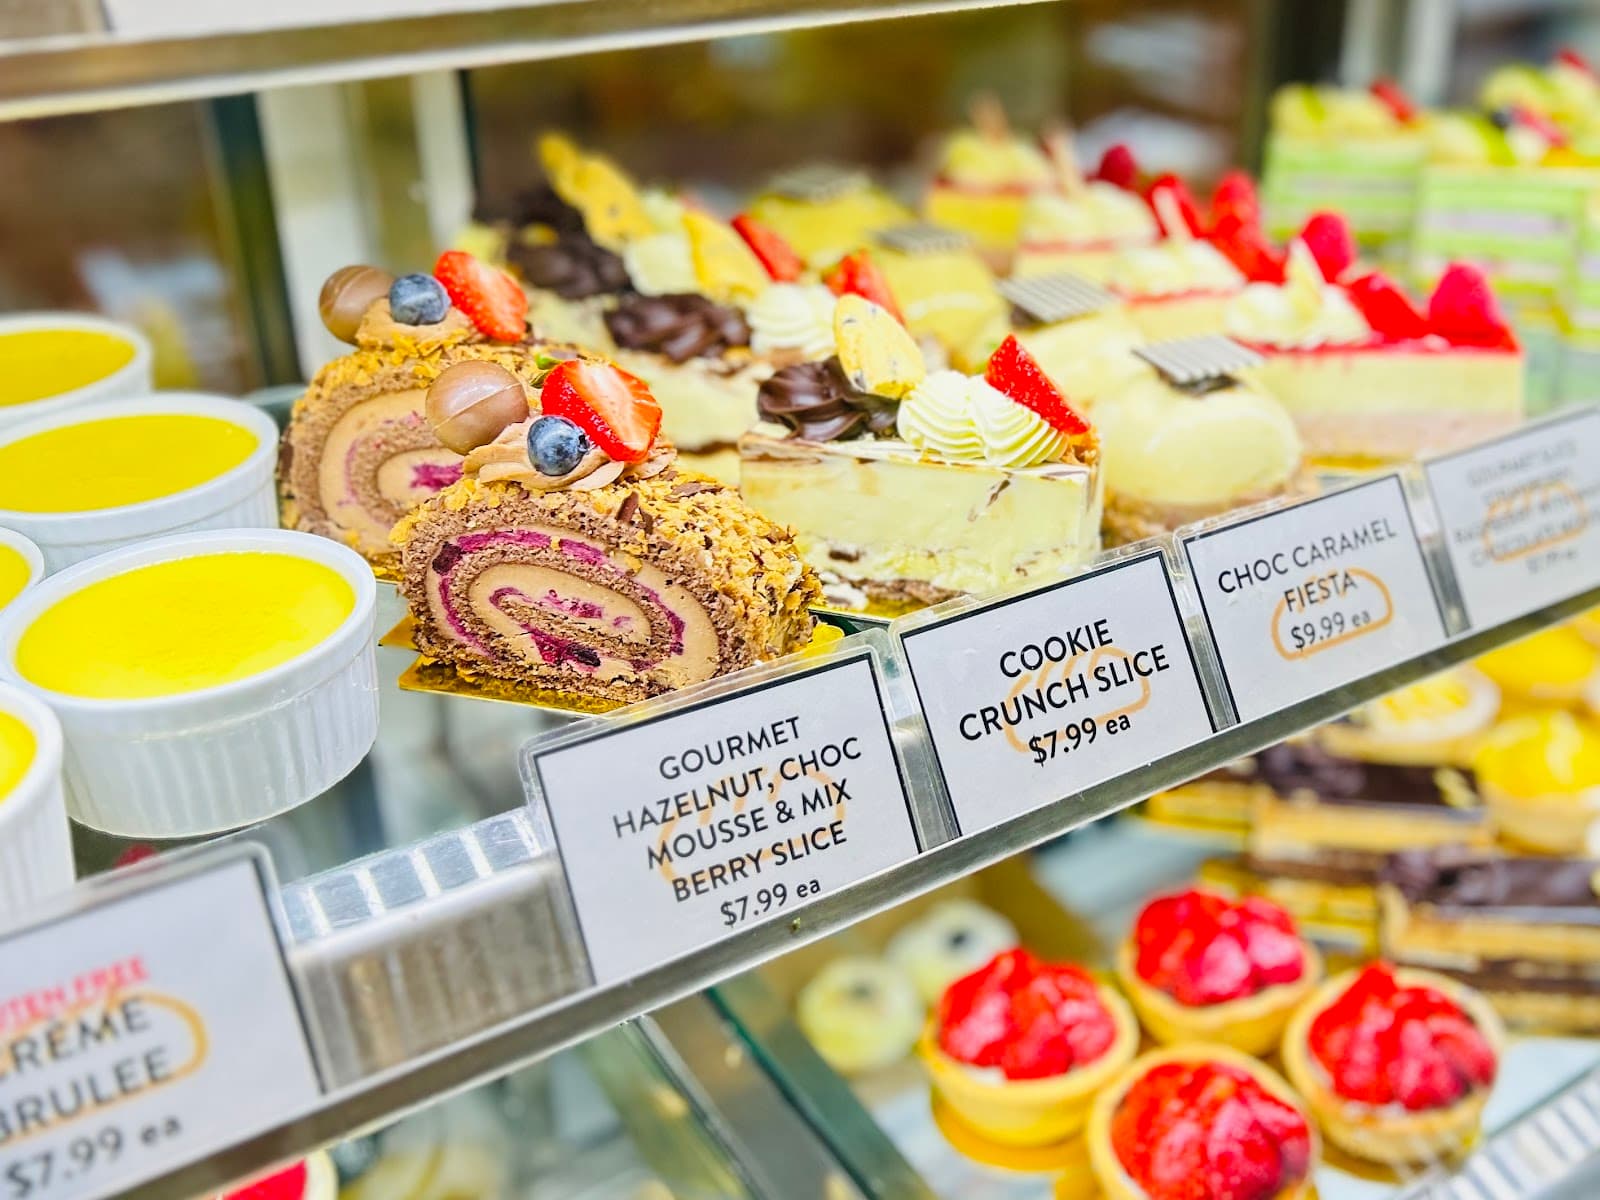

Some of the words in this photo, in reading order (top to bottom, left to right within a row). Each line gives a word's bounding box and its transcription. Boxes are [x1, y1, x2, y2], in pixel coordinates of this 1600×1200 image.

[1218, 553, 1289, 594] CHOC
[1293, 518, 1397, 568] CARAMEL
[1284, 571, 1358, 613] FIESTA
[1000, 619, 1113, 678] COOKIE
[1291, 612, 1345, 651] $9.99
[1351, 610, 1371, 627] ea
[959, 673, 1089, 740] CRUNCH
[1093, 644, 1170, 693] SLICE
[659, 716, 801, 779] GOURMET
[1028, 718, 1097, 767] $7.99
[1106, 714, 1131, 735] ea
[612, 767, 775, 838] HAZELNUT,
[779, 736, 862, 781] CHOC
[646, 808, 769, 870] MOUSSE
[775, 800, 795, 824] &
[801, 778, 853, 816] MIX
[672, 848, 763, 902] BERRY
[770, 820, 848, 866] SLICE
[720, 882, 788, 927] $7.99
[796, 878, 821, 899] ea
[73, 955, 149, 1006] FREE
[5, 1126, 124, 1199] $7.99
[140, 1115, 182, 1146] ea
